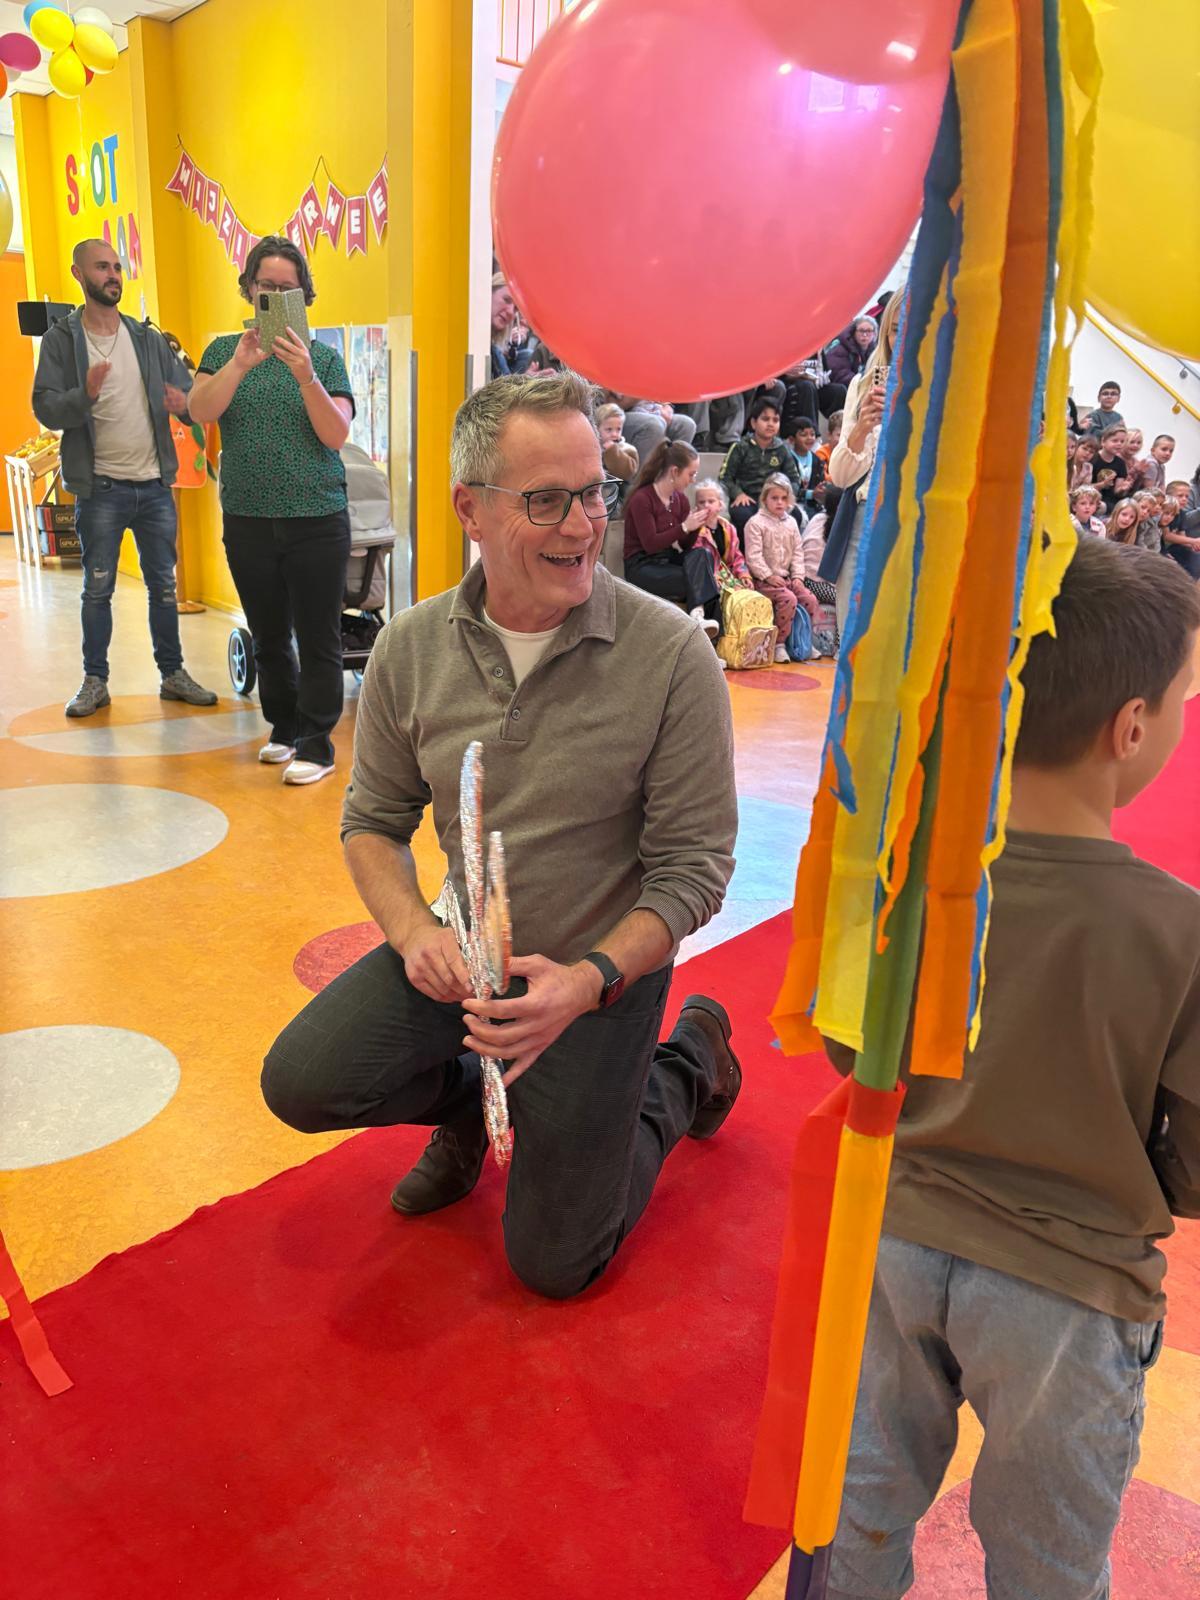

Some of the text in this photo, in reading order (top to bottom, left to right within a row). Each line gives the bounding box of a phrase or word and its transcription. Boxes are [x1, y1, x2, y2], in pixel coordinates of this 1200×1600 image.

[65, 134, 118, 216] SOT
[180, 161, 217, 213] WIJ
[326, 186, 387, 235] WEE
